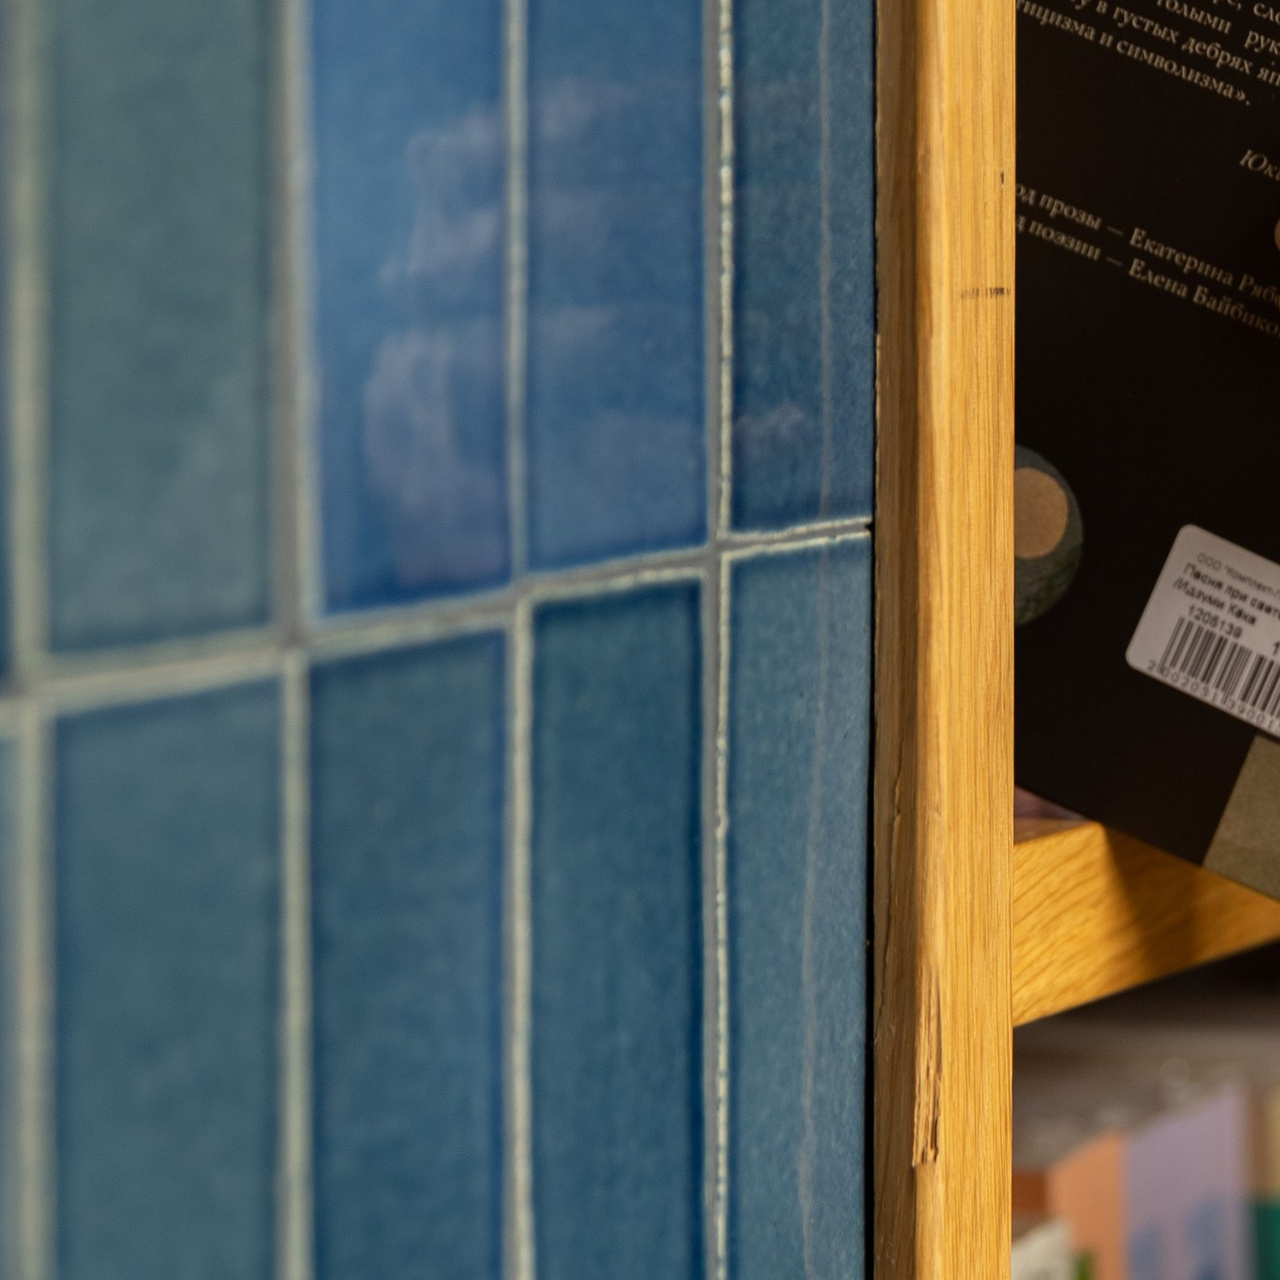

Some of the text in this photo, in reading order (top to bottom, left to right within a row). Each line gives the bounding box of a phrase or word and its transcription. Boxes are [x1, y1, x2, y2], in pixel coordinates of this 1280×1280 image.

[1095, 0, 1107, 13] в
[1112, 6, 1179, 44] густых
[1181, 37, 1256, 74] дебрях
[1099, 32, 1113, 47] и
[1116, 40, 1249, 105] символизма».
[1028, 220, 1101, 261] поэзии
[1128, 257, 1188, 298] Елена
[1038, 193, 1102, 230] прозы
[1128, 227, 1233, 286] Екатерина
[1238, 273, 1280, 304] Ряб
[1183, 562, 1224, 590] Песня
[1224, 585, 1248, 603] при
